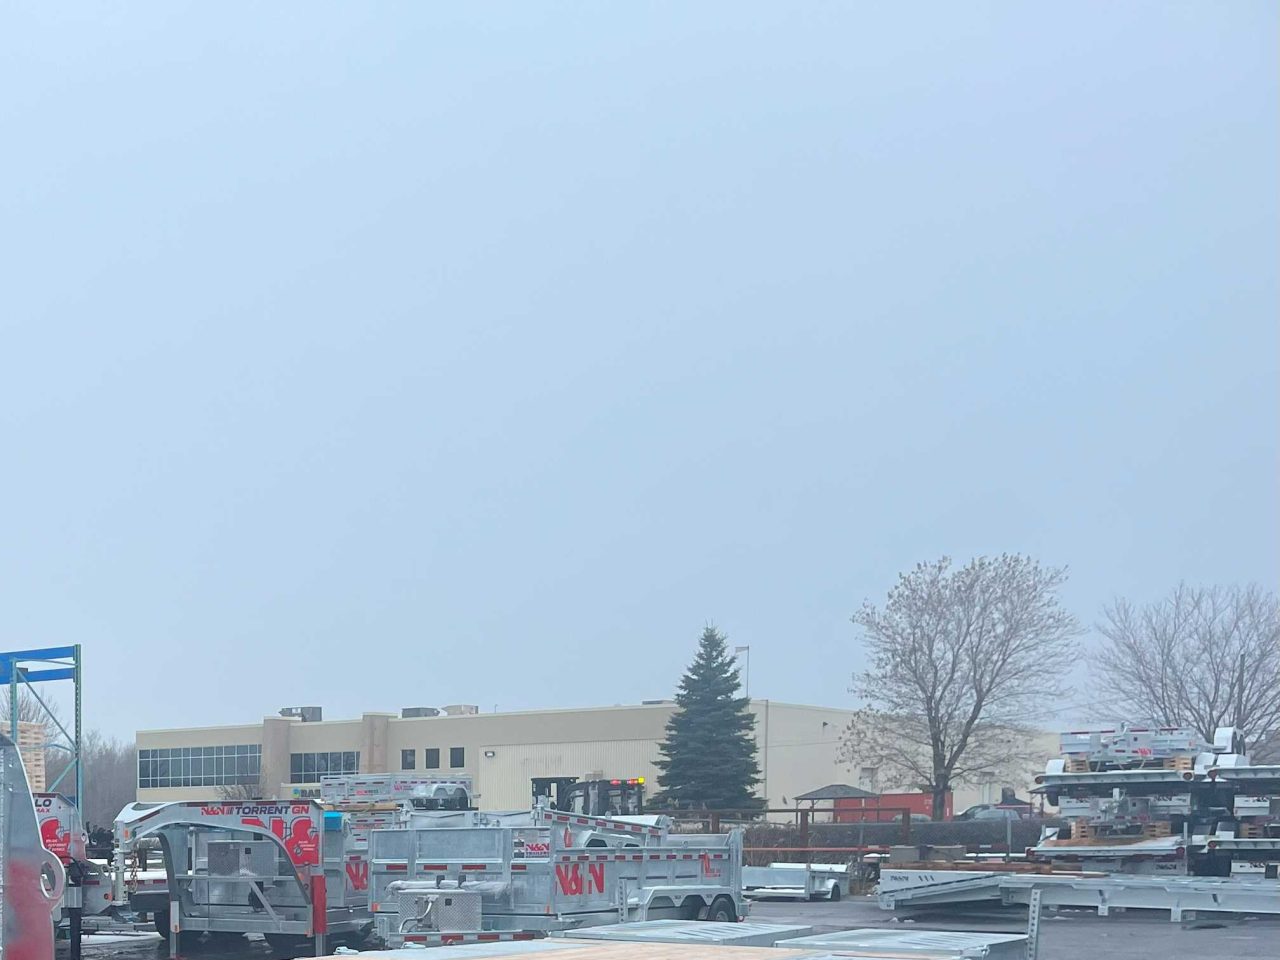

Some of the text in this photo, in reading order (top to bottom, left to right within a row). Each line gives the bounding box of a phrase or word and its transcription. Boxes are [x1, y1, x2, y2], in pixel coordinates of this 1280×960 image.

[236, 806, 290, 815] TORRENT
[292, 806, 309, 814] GN
[526, 843, 549, 851] N&N
